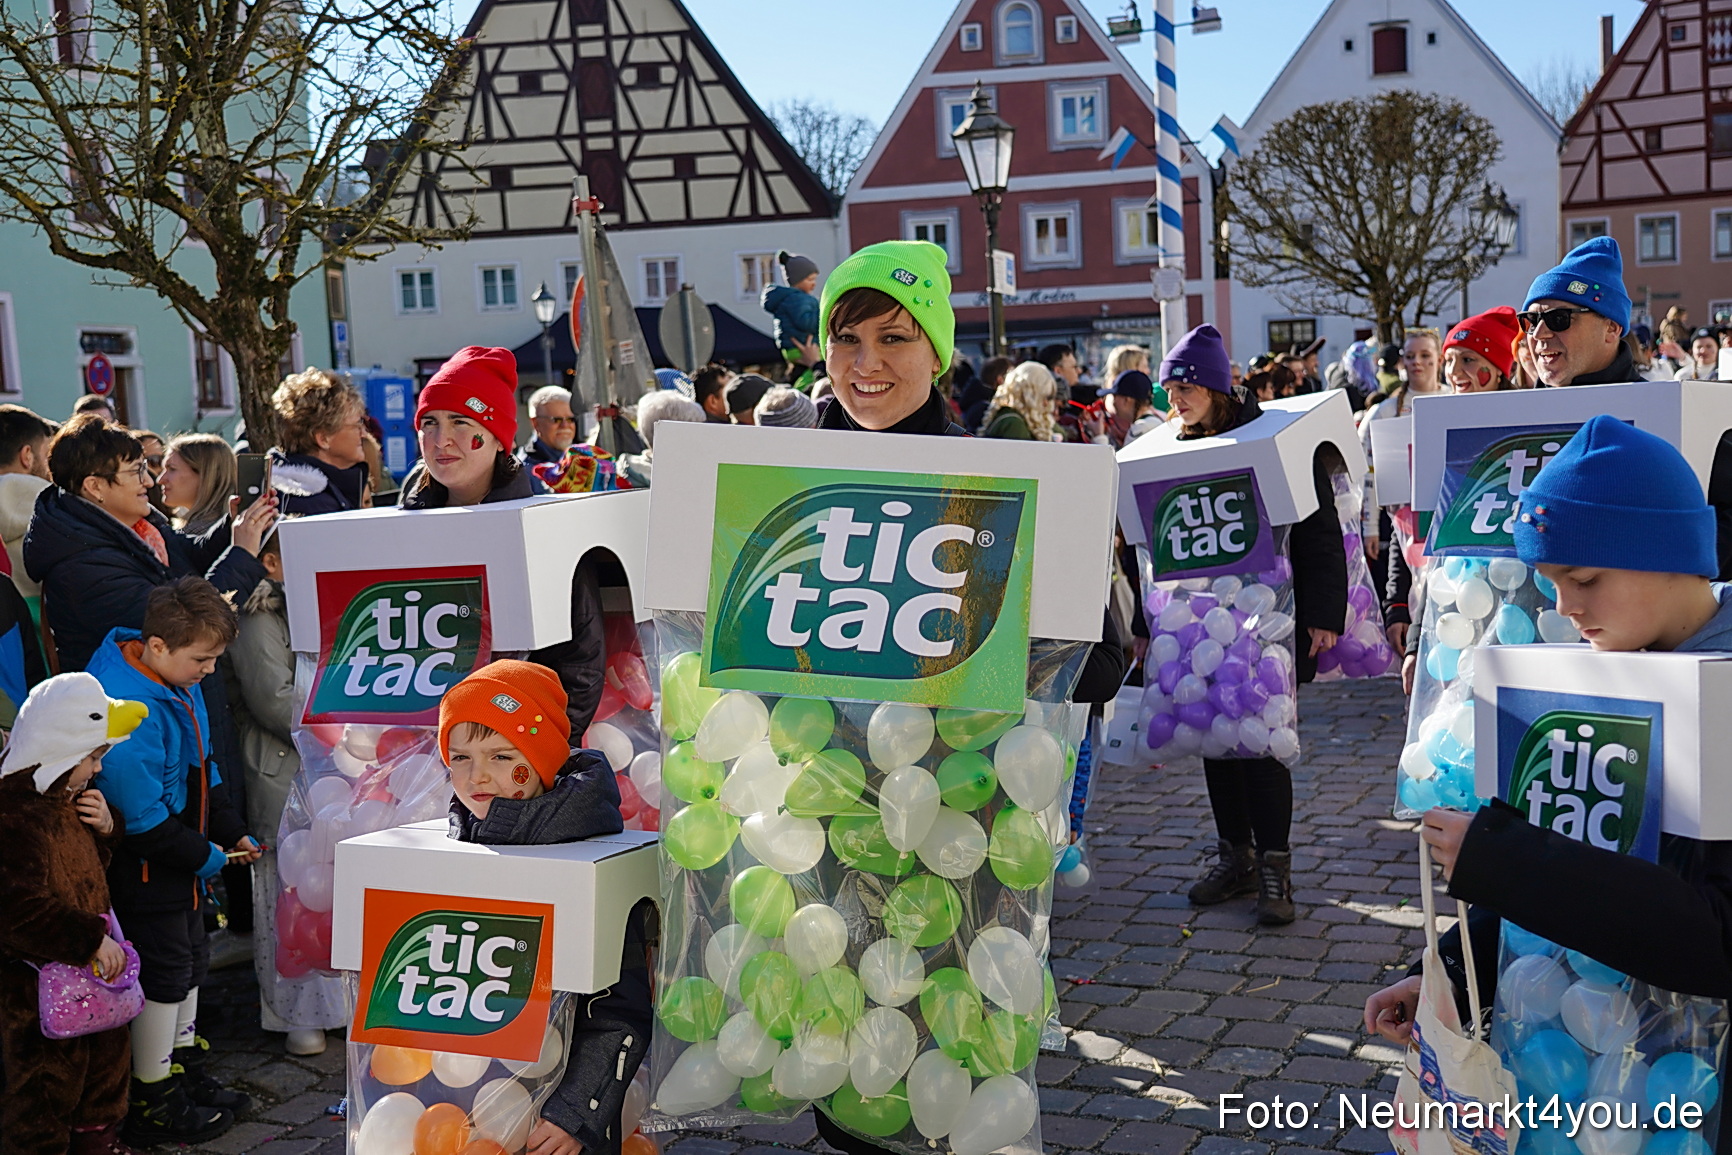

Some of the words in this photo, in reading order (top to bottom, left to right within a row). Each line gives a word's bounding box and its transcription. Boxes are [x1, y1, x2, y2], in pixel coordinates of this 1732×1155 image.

[1167, 521, 1246, 560] tac
[764, 572, 963, 657] tac
[344, 646, 456, 697] tac
[1526, 780, 1623, 852] tac
[398, 965, 511, 1023] tac
